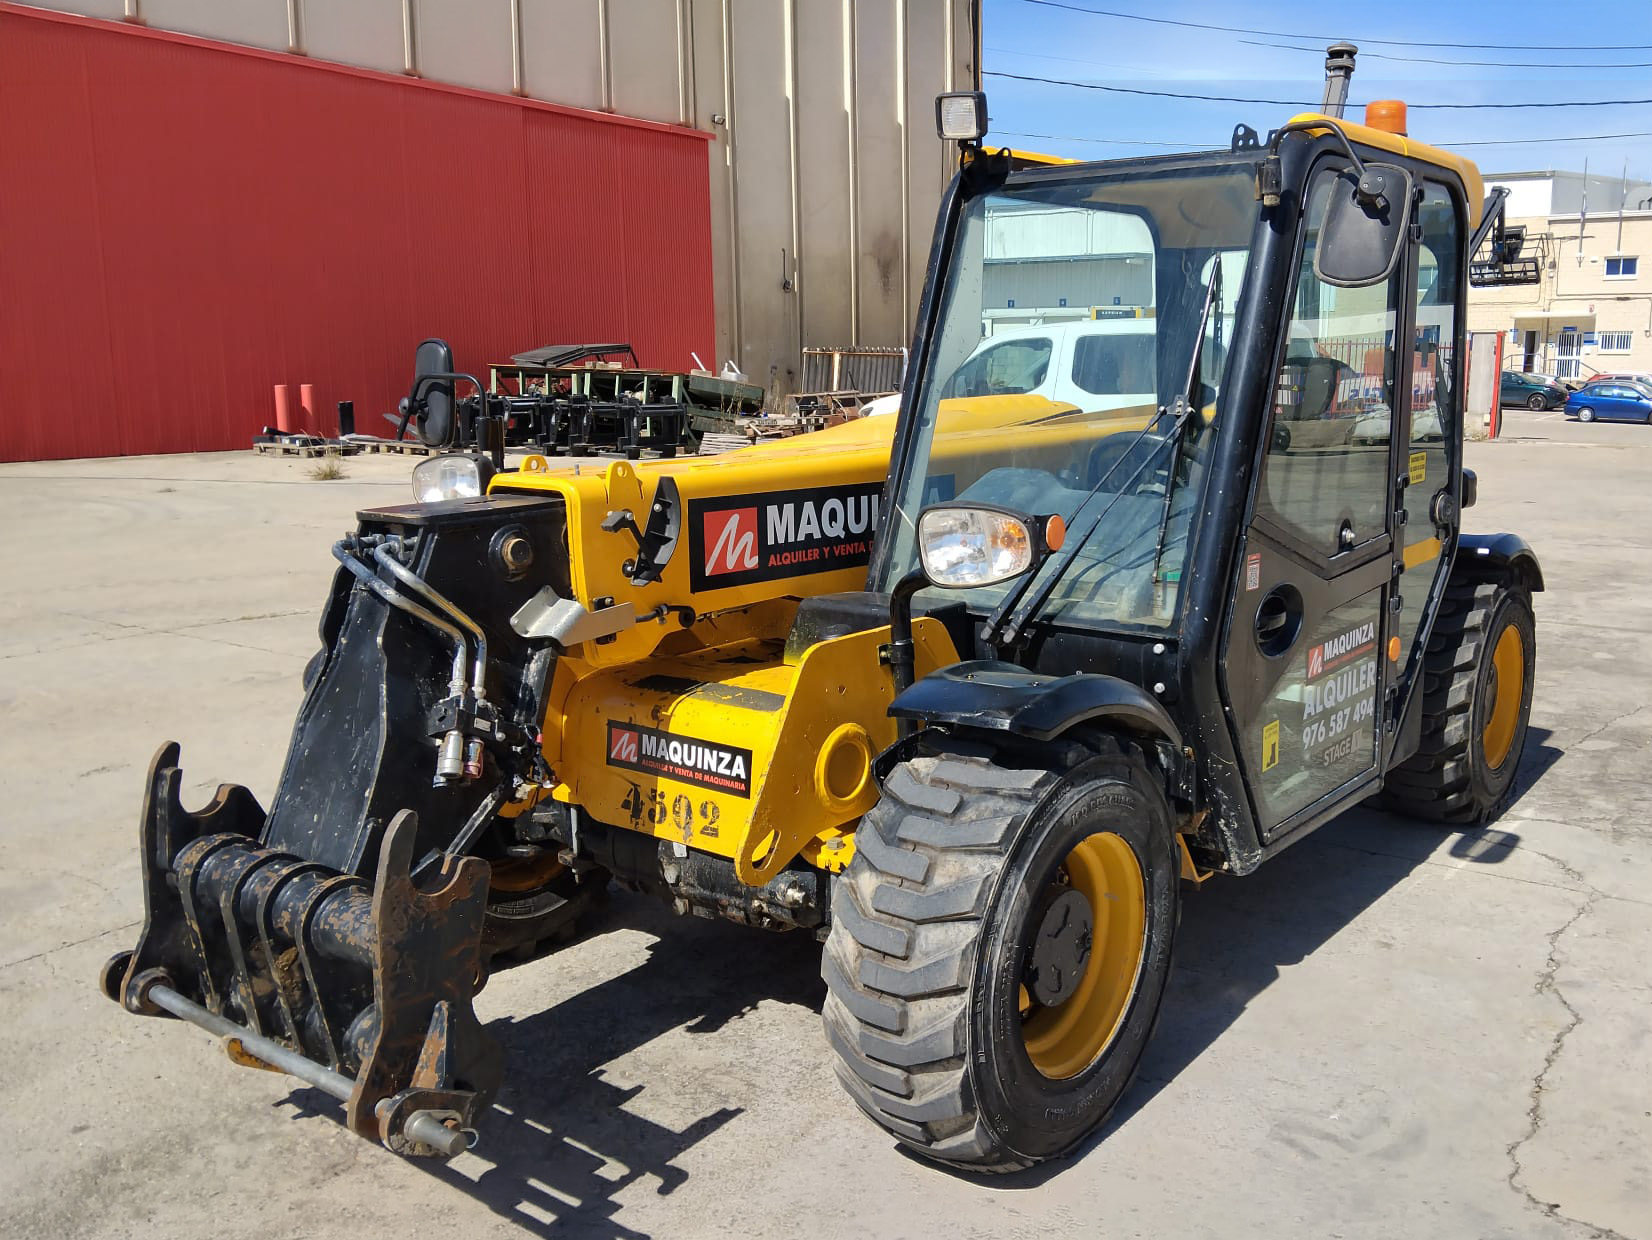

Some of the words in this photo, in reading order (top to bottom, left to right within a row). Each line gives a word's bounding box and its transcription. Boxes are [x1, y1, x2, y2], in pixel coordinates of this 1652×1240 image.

[768, 548, 819, 567] ALQUILER
[823, 546, 831, 559] Y
[833, 542, 866, 557] VENTA
[1324, 622, 1374, 661] MAQUINZA
[1303, 661, 1376, 720] ALQUILER
[1303, 719, 1326, 749] 976
[1329, 706, 1351, 737] 587
[1353, 696, 1374, 723] 494
[642, 734, 746, 779] MAQUINZA
[1323, 736, 1351, 767] STAGE
[674, 766, 693, 778] VENTA
[695, 772, 702, 780] DE
[704, 774, 745, 791] MAQUINARIA
